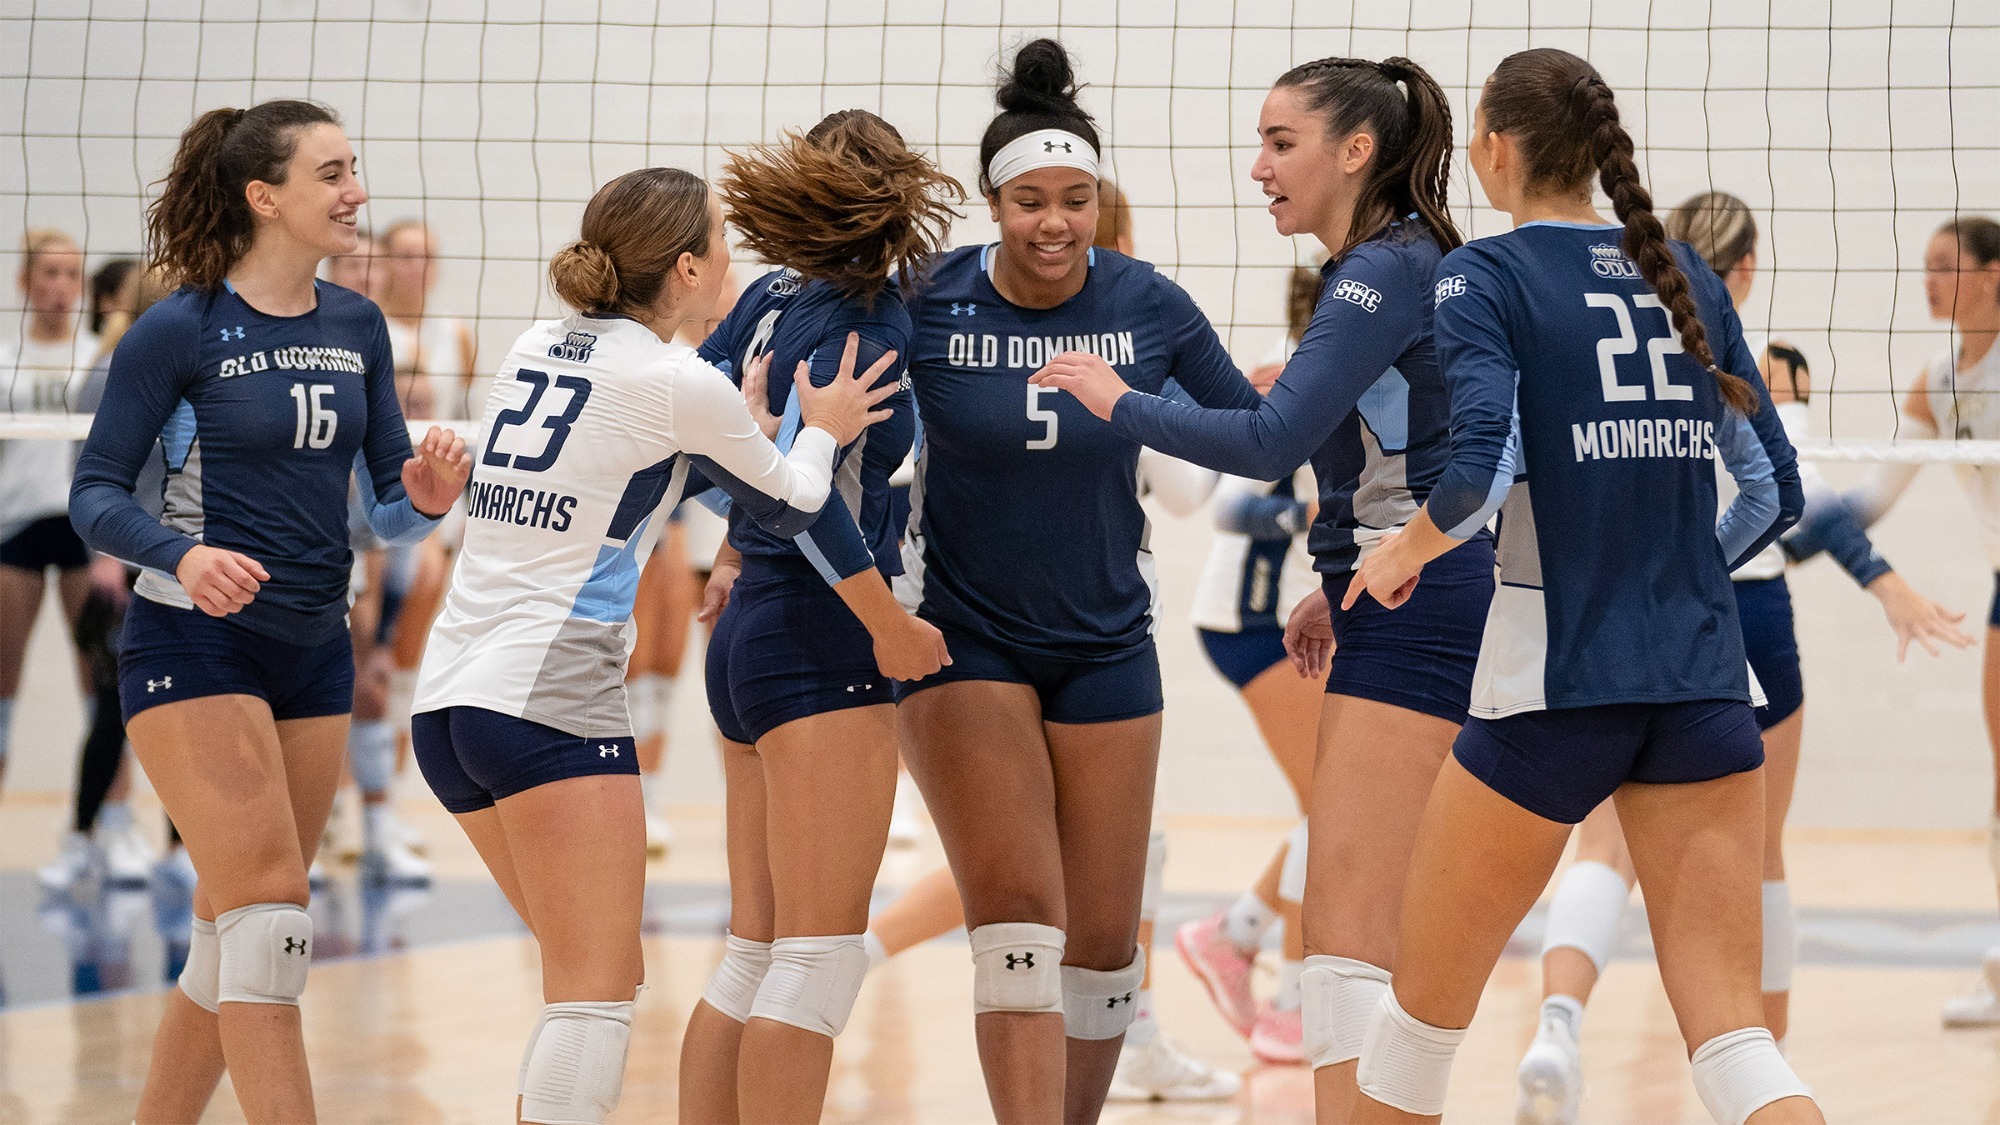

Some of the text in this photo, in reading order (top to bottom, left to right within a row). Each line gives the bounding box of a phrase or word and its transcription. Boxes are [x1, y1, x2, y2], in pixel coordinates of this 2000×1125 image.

[1592, 259, 1641, 278] ODU
[1333, 279, 1382, 313] SBC
[219, 351, 269, 378] OLD
[547, 343, 593, 363] ODU
[948, 333, 998, 368] OLD
[1584, 293, 1694, 402] 22
[290, 383, 338, 449] 16
[482, 368, 593, 473] 23
[1026, 383, 1059, 450] 5
[1571, 418, 1715, 463] MONARCHS
[468, 481, 578, 533] ONARCHS
